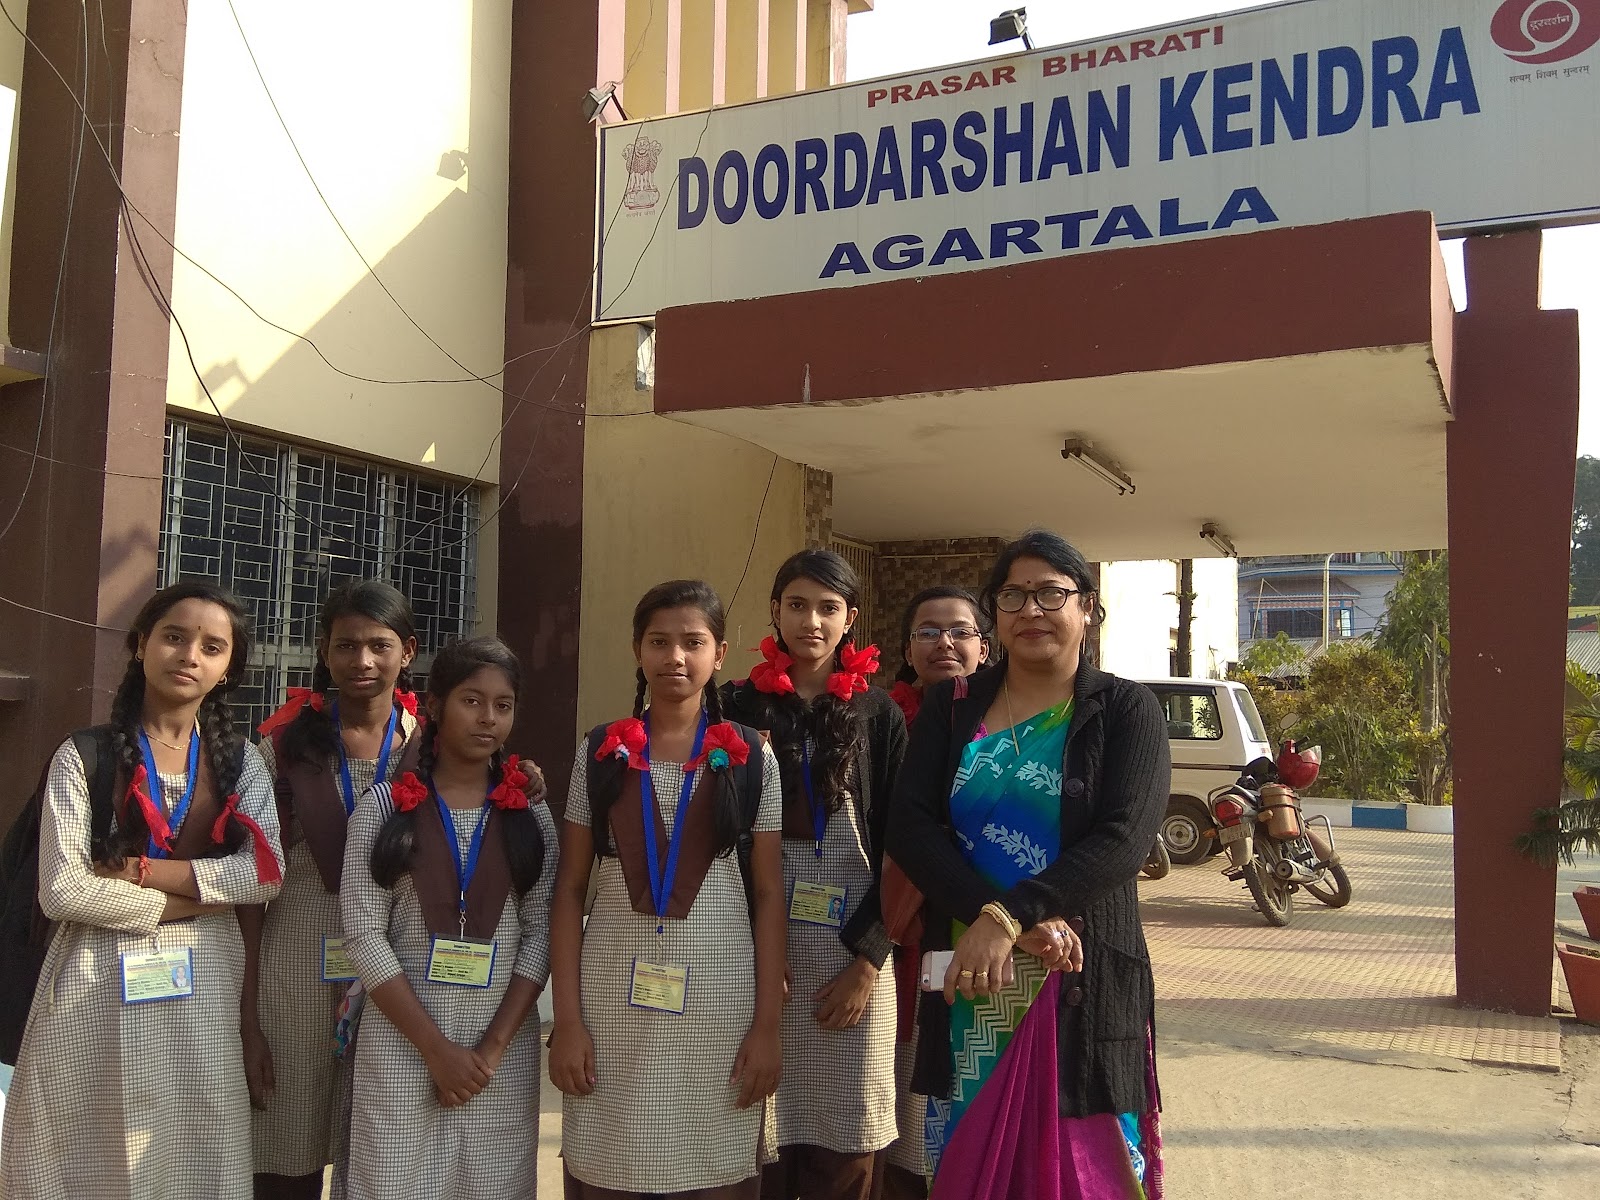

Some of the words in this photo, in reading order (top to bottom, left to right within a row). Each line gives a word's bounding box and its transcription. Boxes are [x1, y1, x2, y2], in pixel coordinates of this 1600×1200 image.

[868, 66, 1017, 109] PRASAR
[1042, 25, 1223, 77] BHARATI
[677, 85, 1131, 230] DOORDARSHAN
[1158, 26, 1481, 162] KENDRA
[819, 187, 1278, 279] AGARTALA
